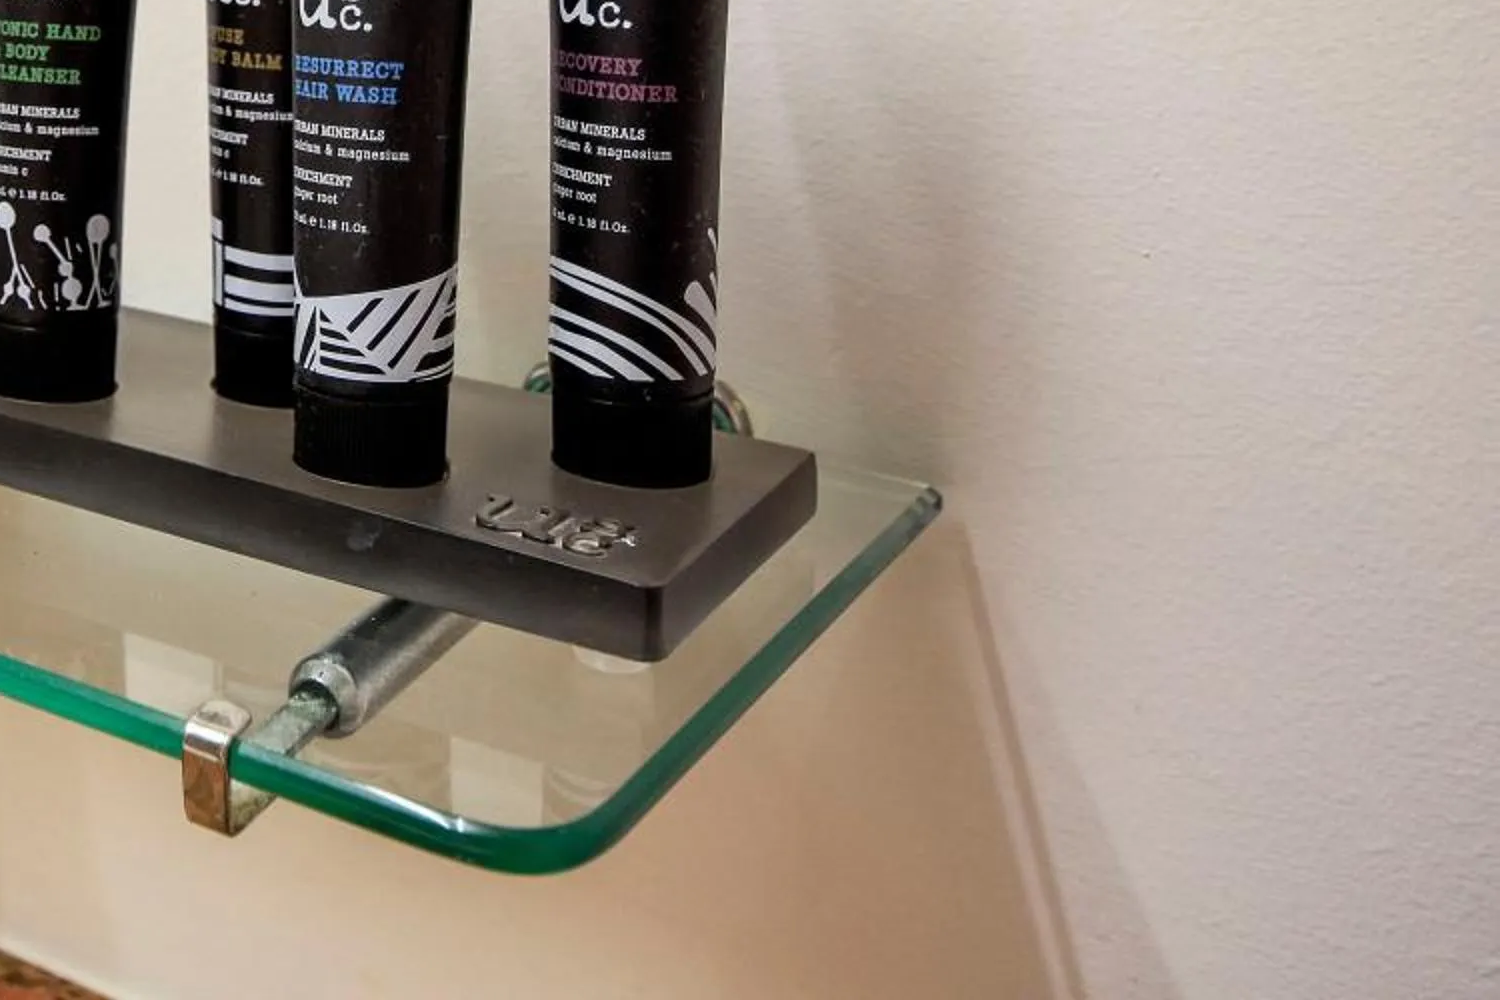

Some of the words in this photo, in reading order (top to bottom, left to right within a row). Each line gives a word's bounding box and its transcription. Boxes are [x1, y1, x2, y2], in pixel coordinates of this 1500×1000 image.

[45, 23, 101, 41] HAND
[5, 43, 50, 61] BODY
[336, 83, 398, 105] WASH
[20, 105, 80, 119] MINERALS
[321, 123, 386, 142] MINERALS
[580, 121, 646, 141] MINERALS
[596, 145, 673, 161] magnesium
